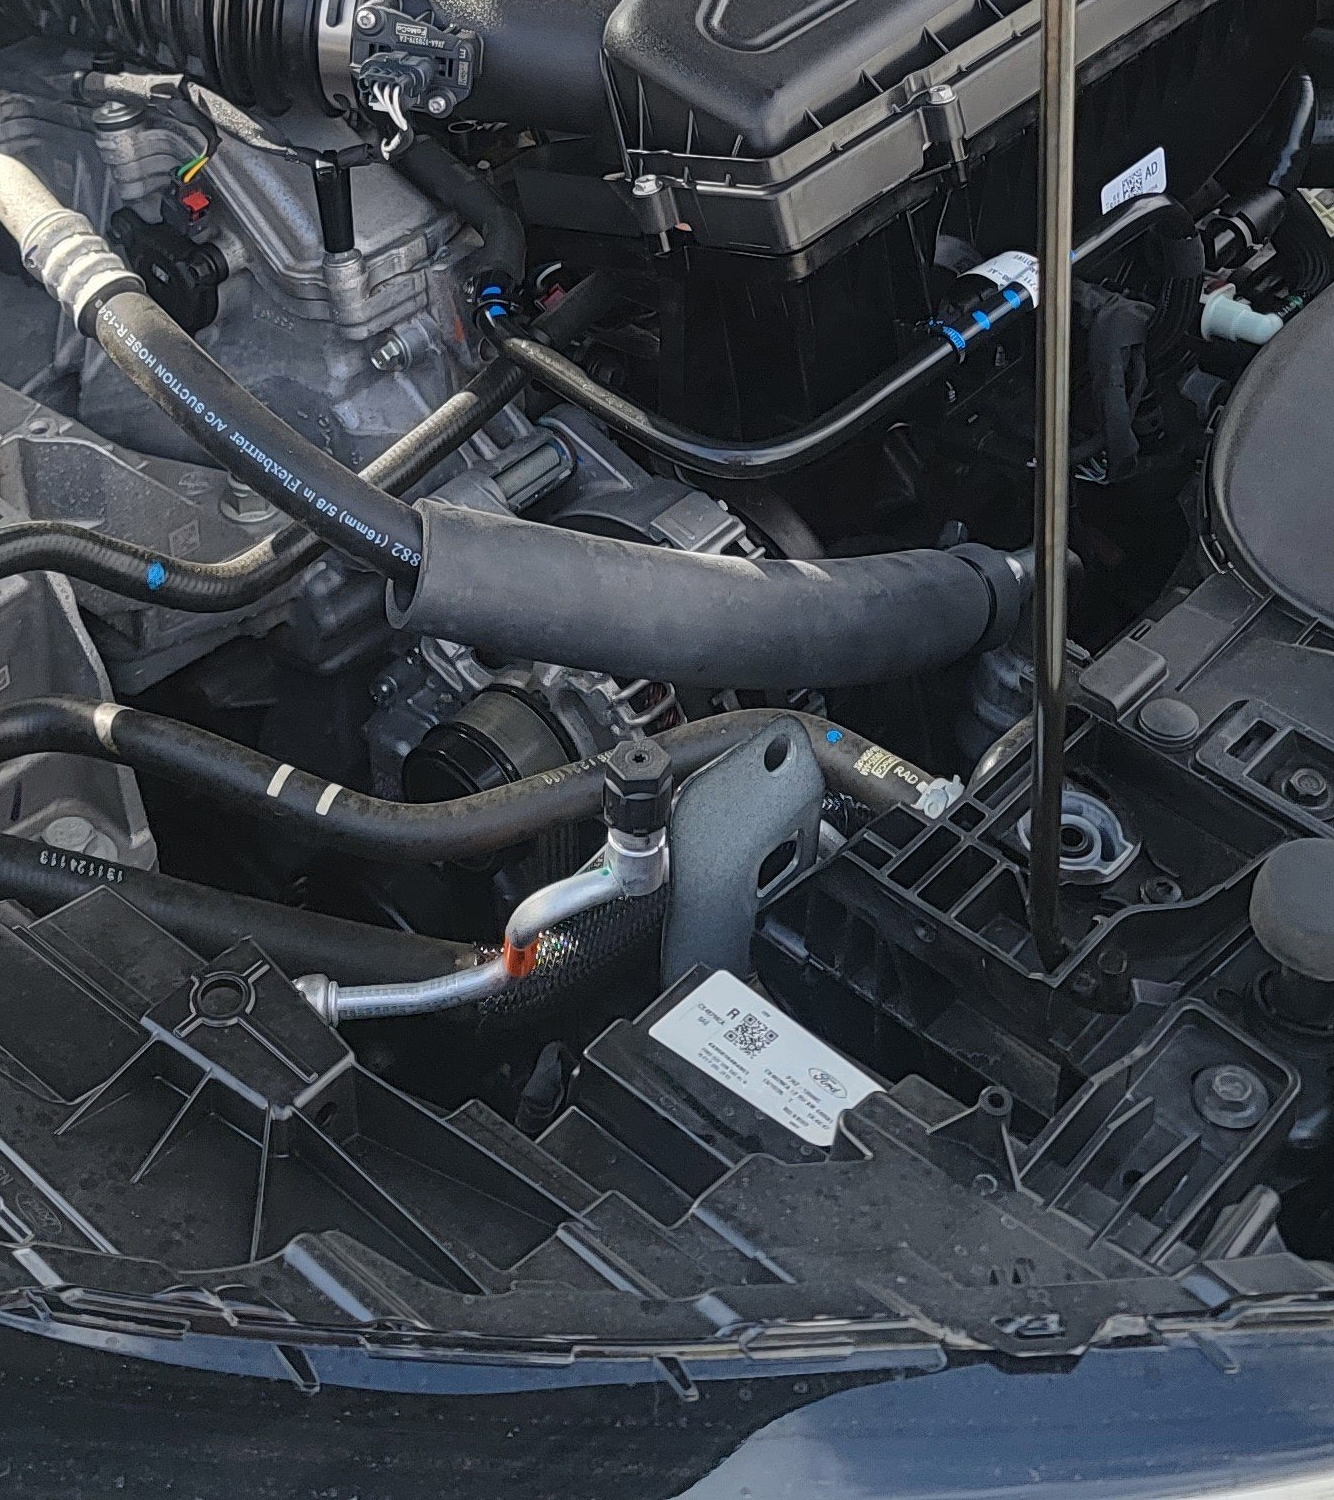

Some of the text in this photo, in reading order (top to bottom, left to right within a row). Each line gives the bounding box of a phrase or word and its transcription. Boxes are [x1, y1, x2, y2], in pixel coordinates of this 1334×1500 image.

[1145, 162, 1158, 180] AD
[125, 333, 157, 368] HOSE
[154, 364, 205, 414] SUCTION
[205, 411, 228, 432] A/C
[229, 431, 303, 494] Flexbarrier
[316, 498, 338, 516] 5/8
[339, 510, 389, 547] (16mm)
[893, 766, 918, 784] RAD
[726, 1008, 740, 1020] R
